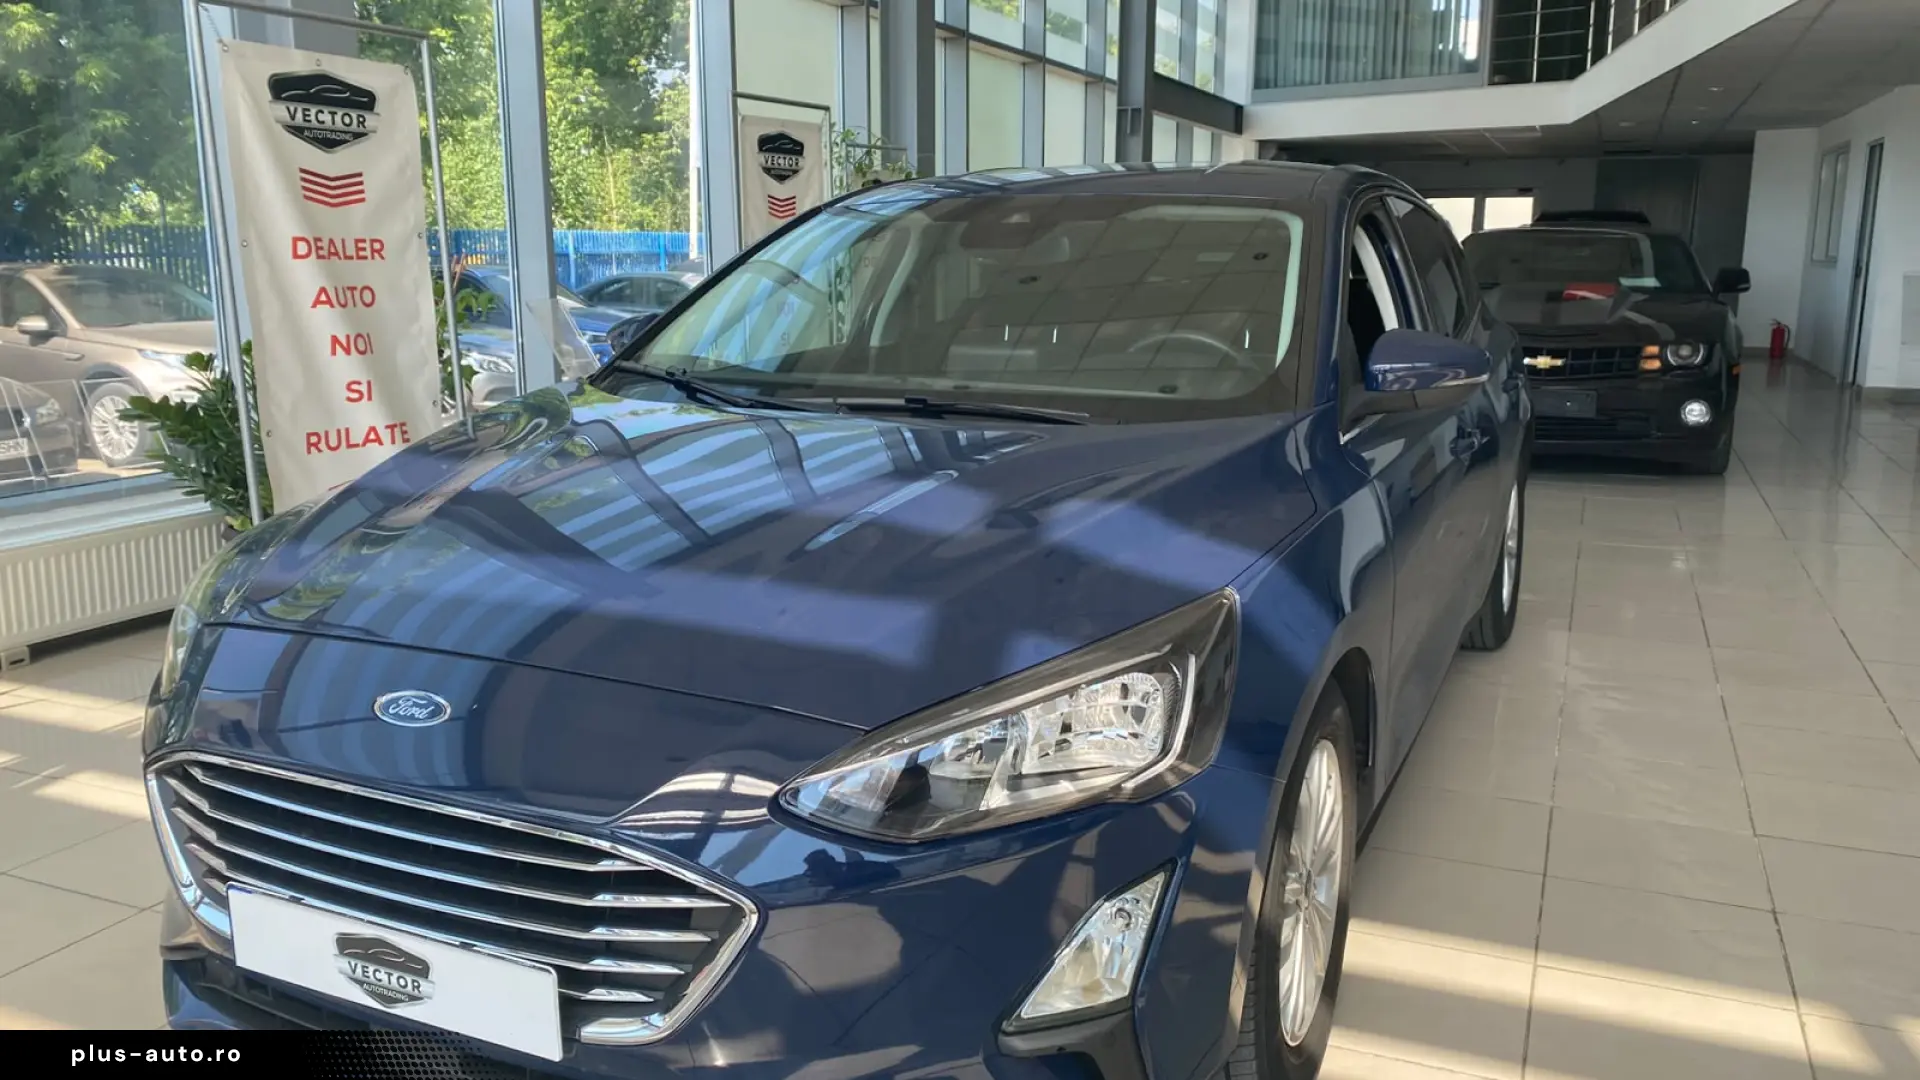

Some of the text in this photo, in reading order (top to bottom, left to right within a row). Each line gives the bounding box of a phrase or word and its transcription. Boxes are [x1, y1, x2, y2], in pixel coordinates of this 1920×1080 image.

[286, 105, 367, 129] VECTOR
[763, 154, 800, 168] VECTOR
[291, 236, 386, 261] DEALER
[310, 285, 376, 309] AUTO
[330, 332, 374, 357] NOI
[344, 379, 373, 403] SI
[305, 421, 410, 456] RULATE
[388, 696, 435, 719] Ford
[347, 960, 421, 994] VECTOR
